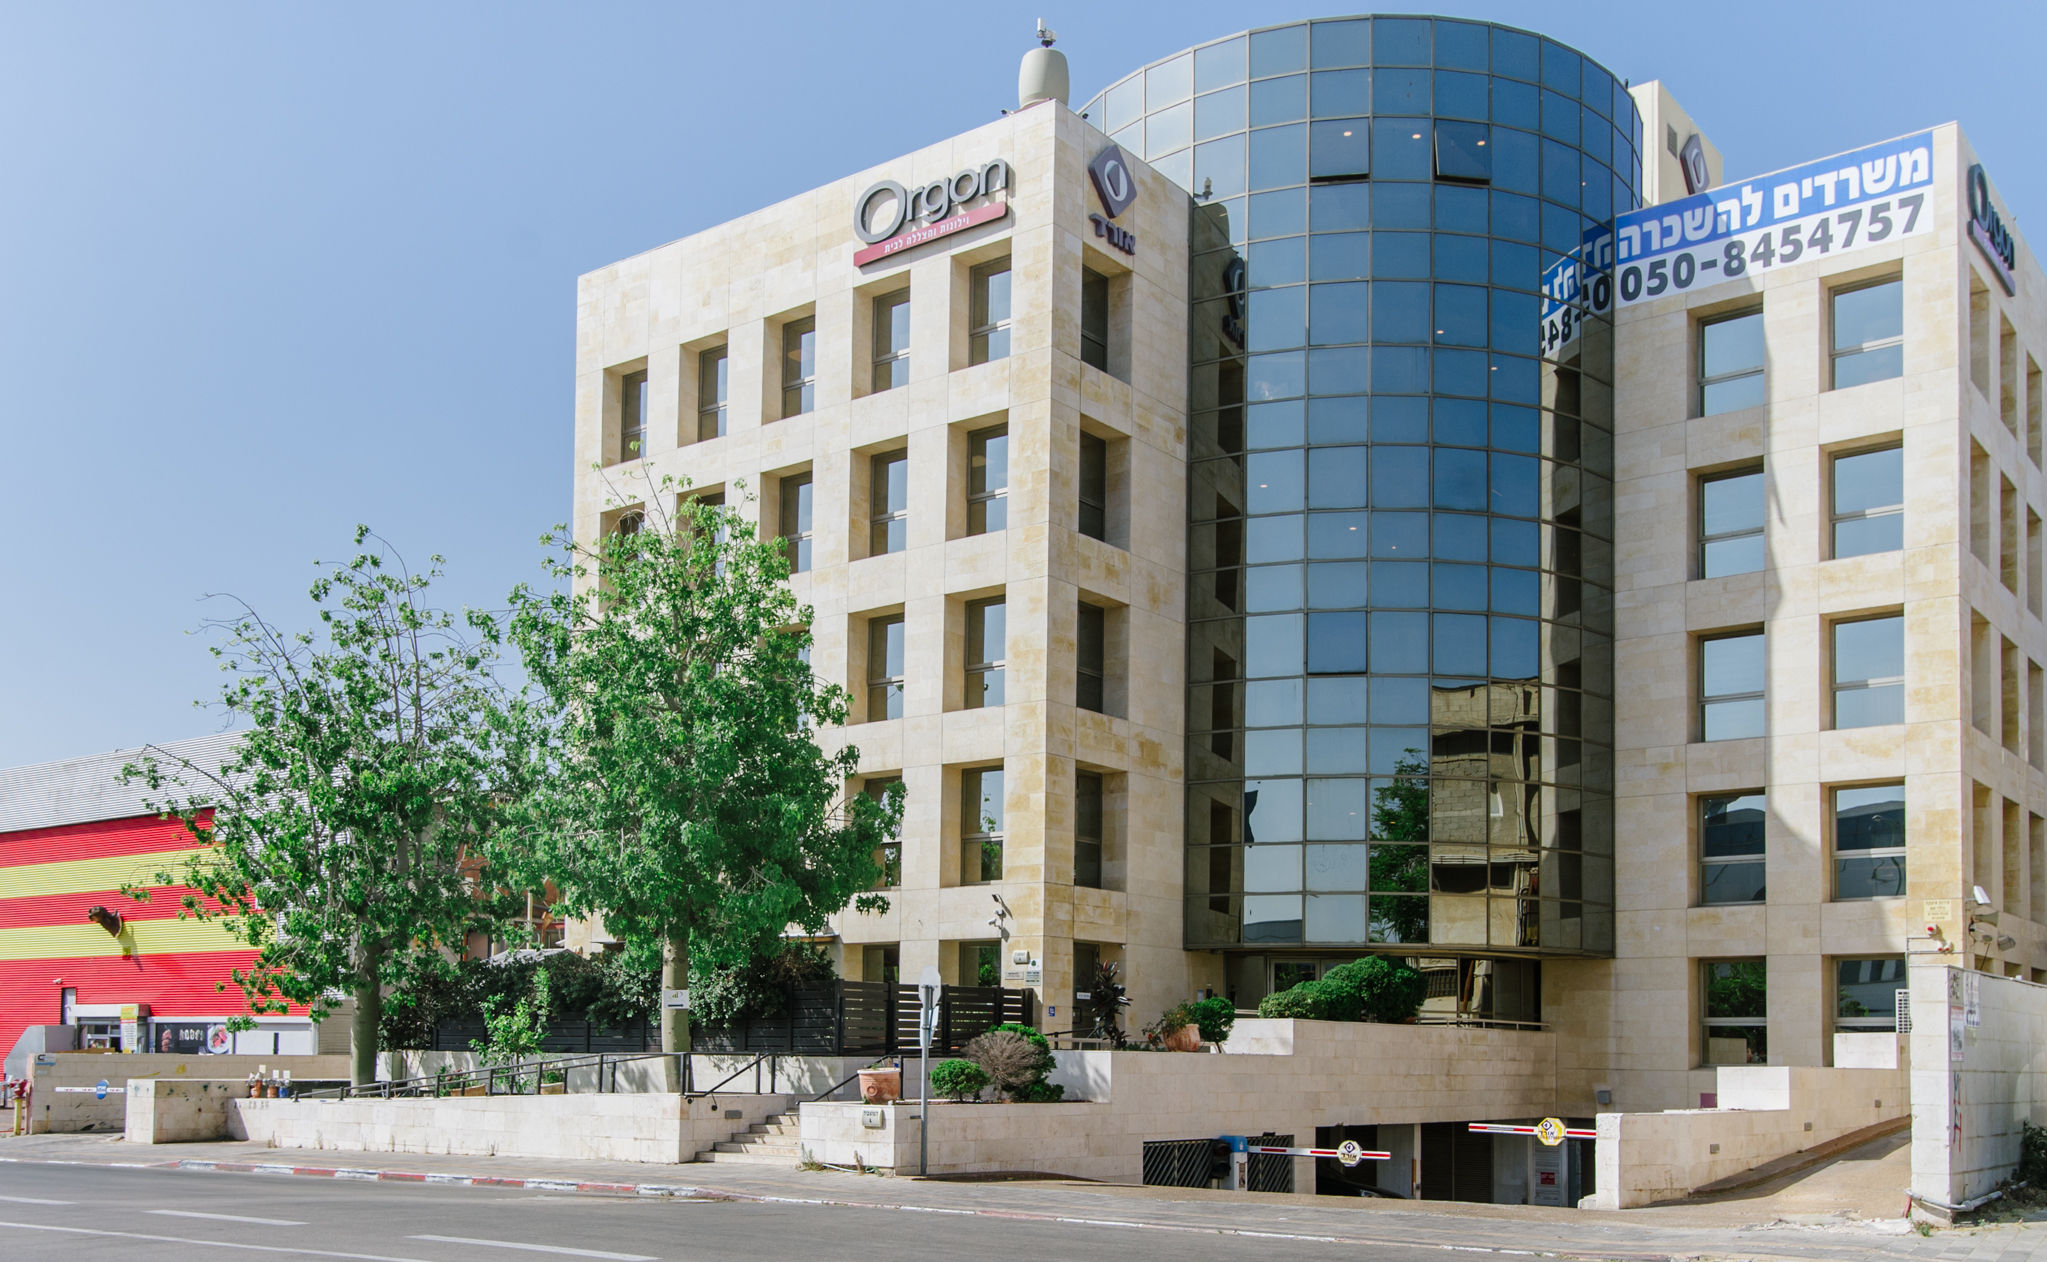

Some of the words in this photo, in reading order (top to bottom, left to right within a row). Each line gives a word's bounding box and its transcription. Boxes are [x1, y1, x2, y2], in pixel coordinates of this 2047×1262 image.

[854, 158, 1008, 244] Orgon
[1773, 145, 1929, 219] משרדים
[884, 239, 903, 253] לבית
[906, 229, 937, 245] והצללה
[939, 216, 970, 233] וילונות
[1089, 212, 1136, 256] אורד
[1618, 184, 1764, 257] להשכרה
[1620, 192, 1925, 303] 050-8454757
